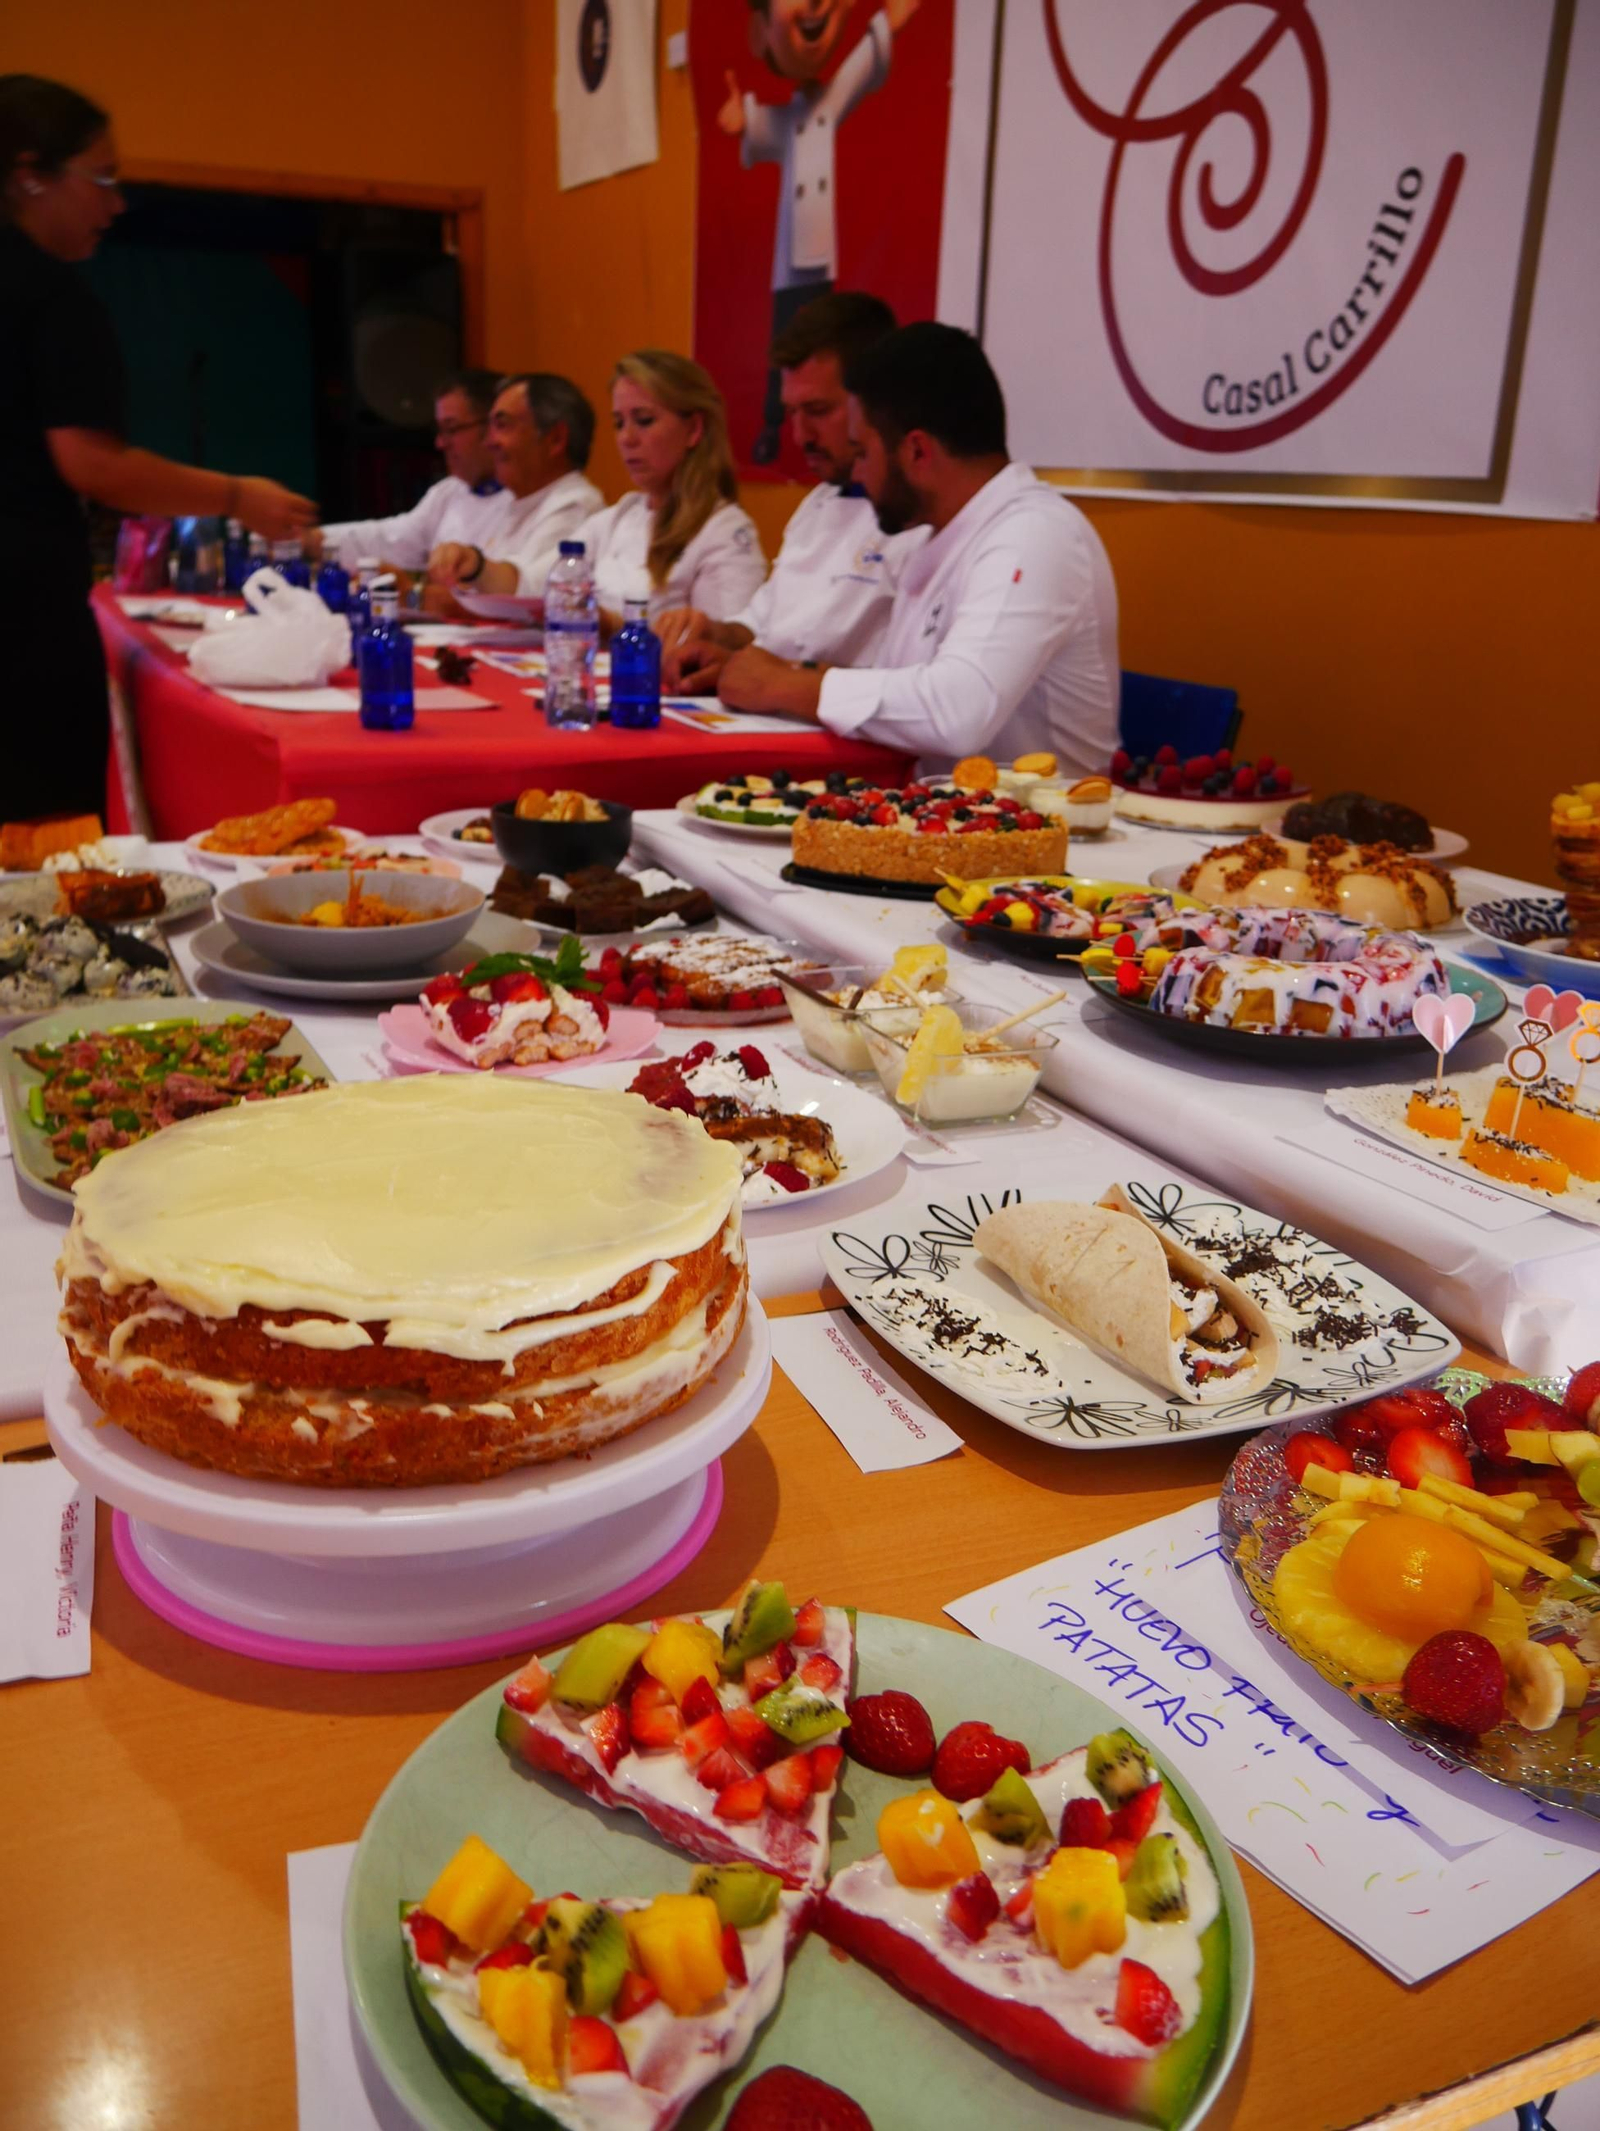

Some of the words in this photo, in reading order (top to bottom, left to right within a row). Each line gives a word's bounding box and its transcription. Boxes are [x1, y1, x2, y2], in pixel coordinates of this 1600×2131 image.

[1203, 352, 1298, 415] Casal
[1304, 166, 1424, 375] Carrillo
[1460, 1184, 1503, 1203] David
[884, 1398, 927, 1440] Alejandro
[57, 1582, 79, 1638] Victoria
